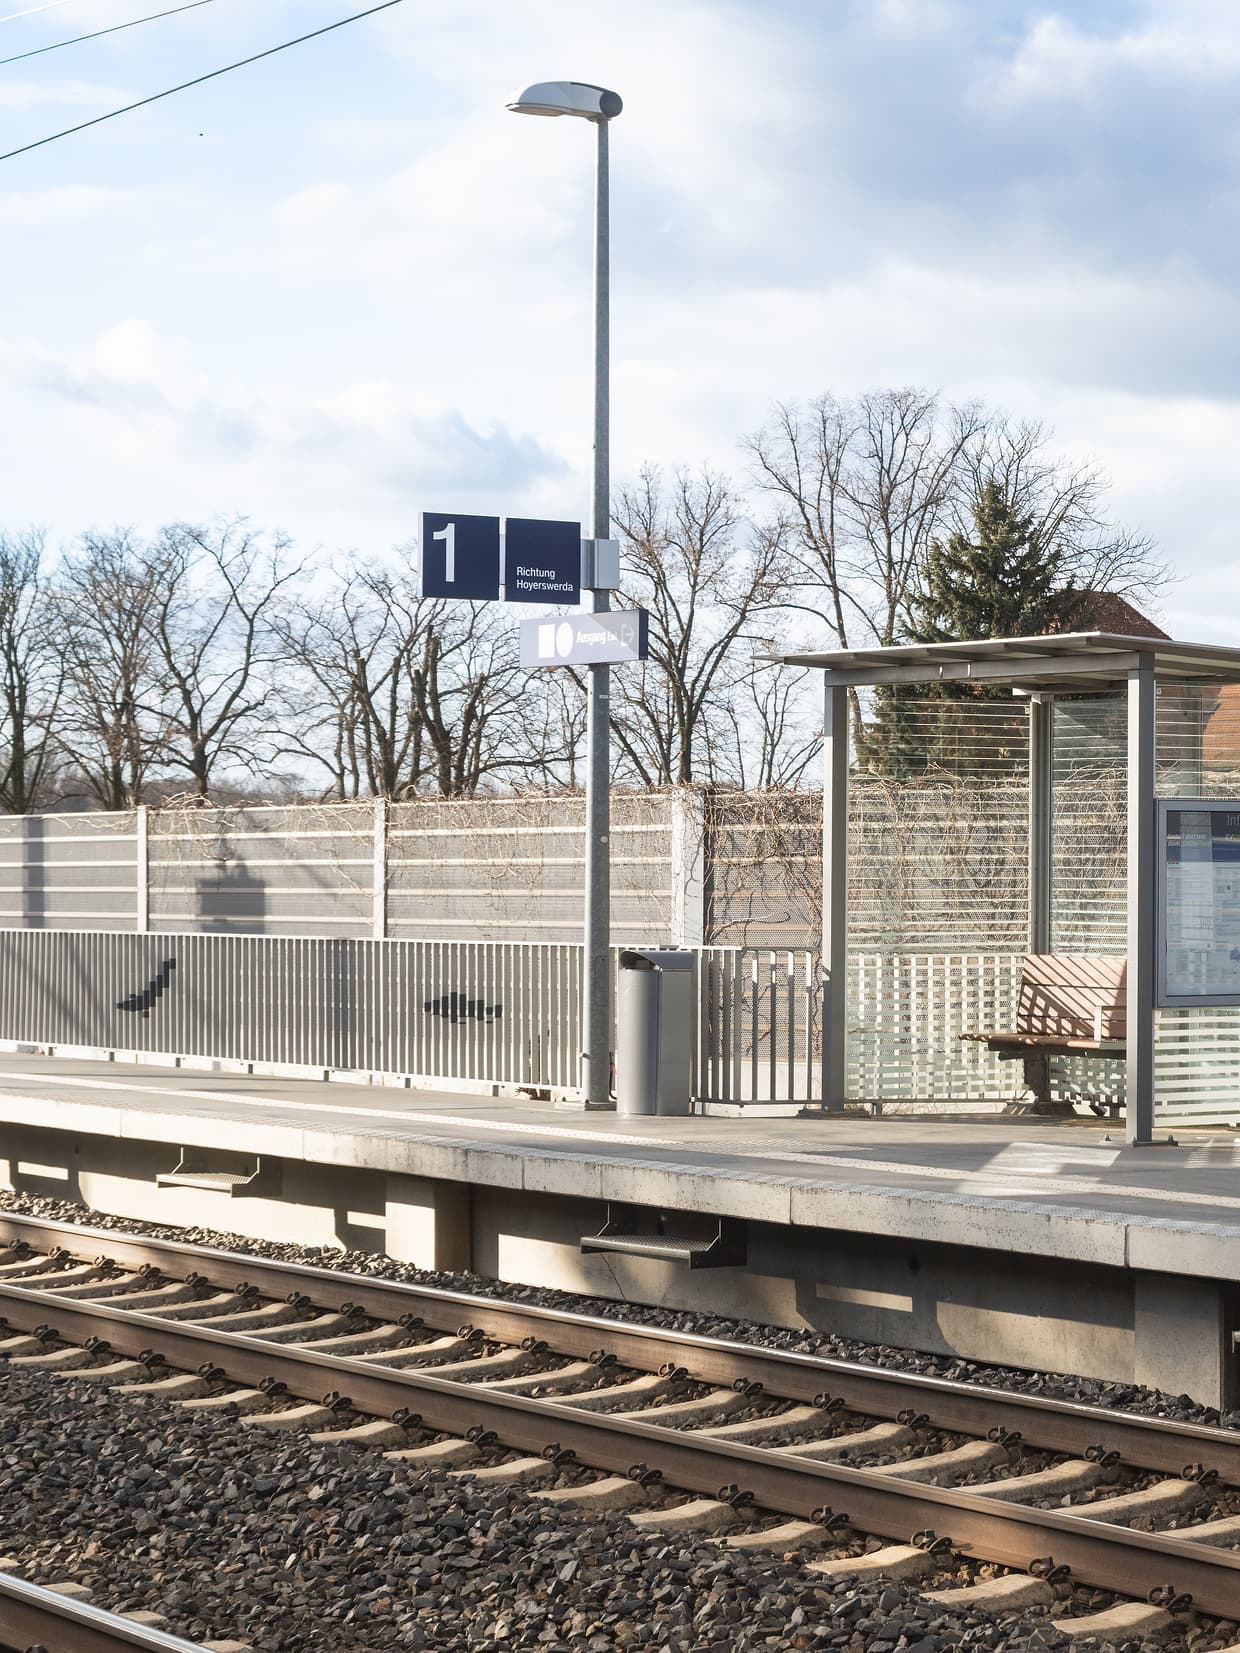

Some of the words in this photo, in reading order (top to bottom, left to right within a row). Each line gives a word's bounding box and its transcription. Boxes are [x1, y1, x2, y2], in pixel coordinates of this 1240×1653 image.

[432, 522, 456, 583] 1
[516, 566, 556, 580] Richtung
[516, 579, 574, 592] Hoyerswerda
[576, 631, 606, 646] Ausgang
